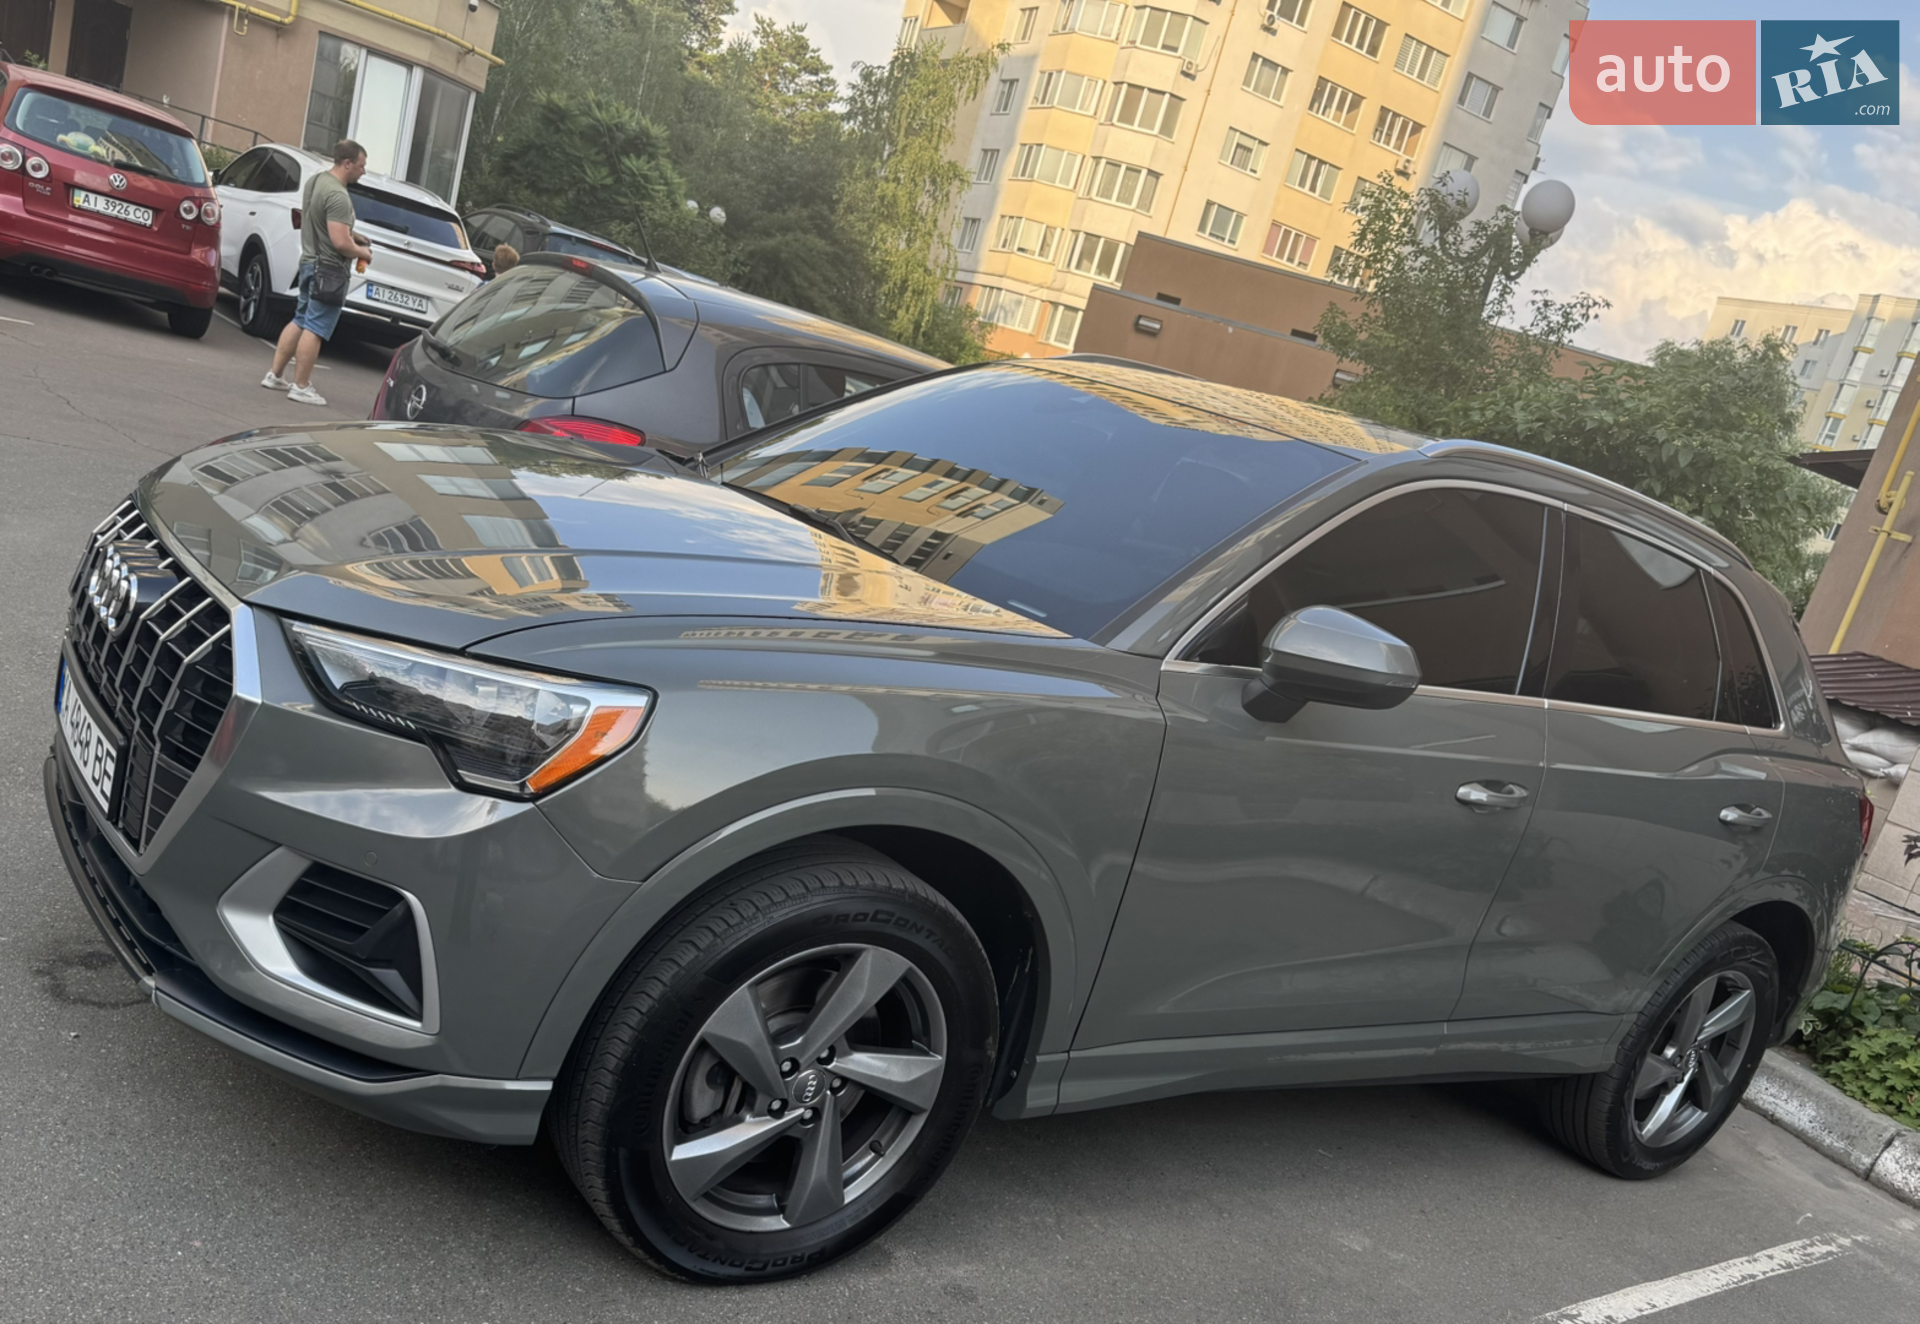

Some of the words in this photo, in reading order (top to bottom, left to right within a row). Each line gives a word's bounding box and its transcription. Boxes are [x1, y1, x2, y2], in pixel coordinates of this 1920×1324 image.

[82, 193, 98, 208] AI
[102, 198, 131, 217] 3926
[133, 207, 151, 222] CO
[373, 287, 385, 299] AI
[387, 291, 410, 305] 2632
[91, 735, 116, 803] BE
